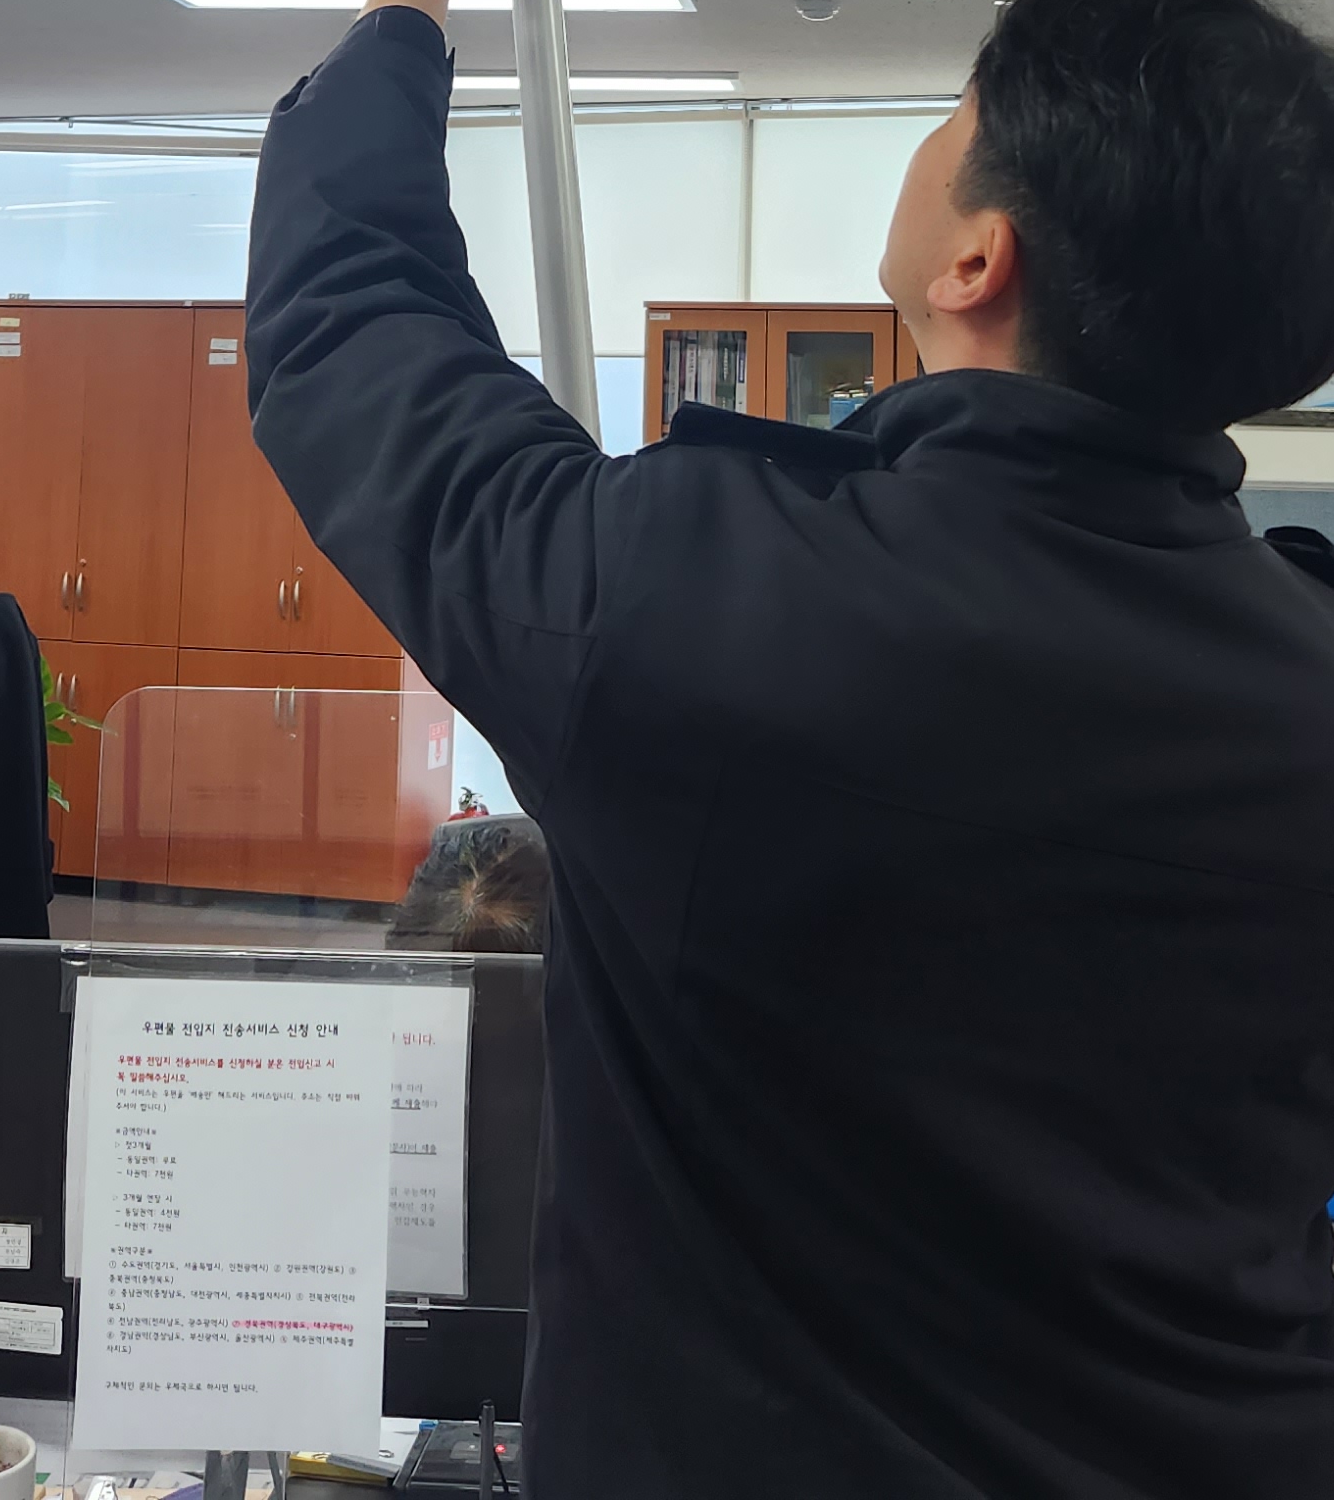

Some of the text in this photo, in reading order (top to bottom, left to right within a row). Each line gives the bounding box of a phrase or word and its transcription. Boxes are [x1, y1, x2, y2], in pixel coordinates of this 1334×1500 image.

[143, 1021, 175, 1036] 우편물
[182, 1022, 216, 1037] 전입지
[287, 1023, 309, 1038] 신청
[316, 1023, 339, 1037] 안내
[402, 1032, 435, 1046] 됩니다.
[326, 1058, 335, 1068] 시
